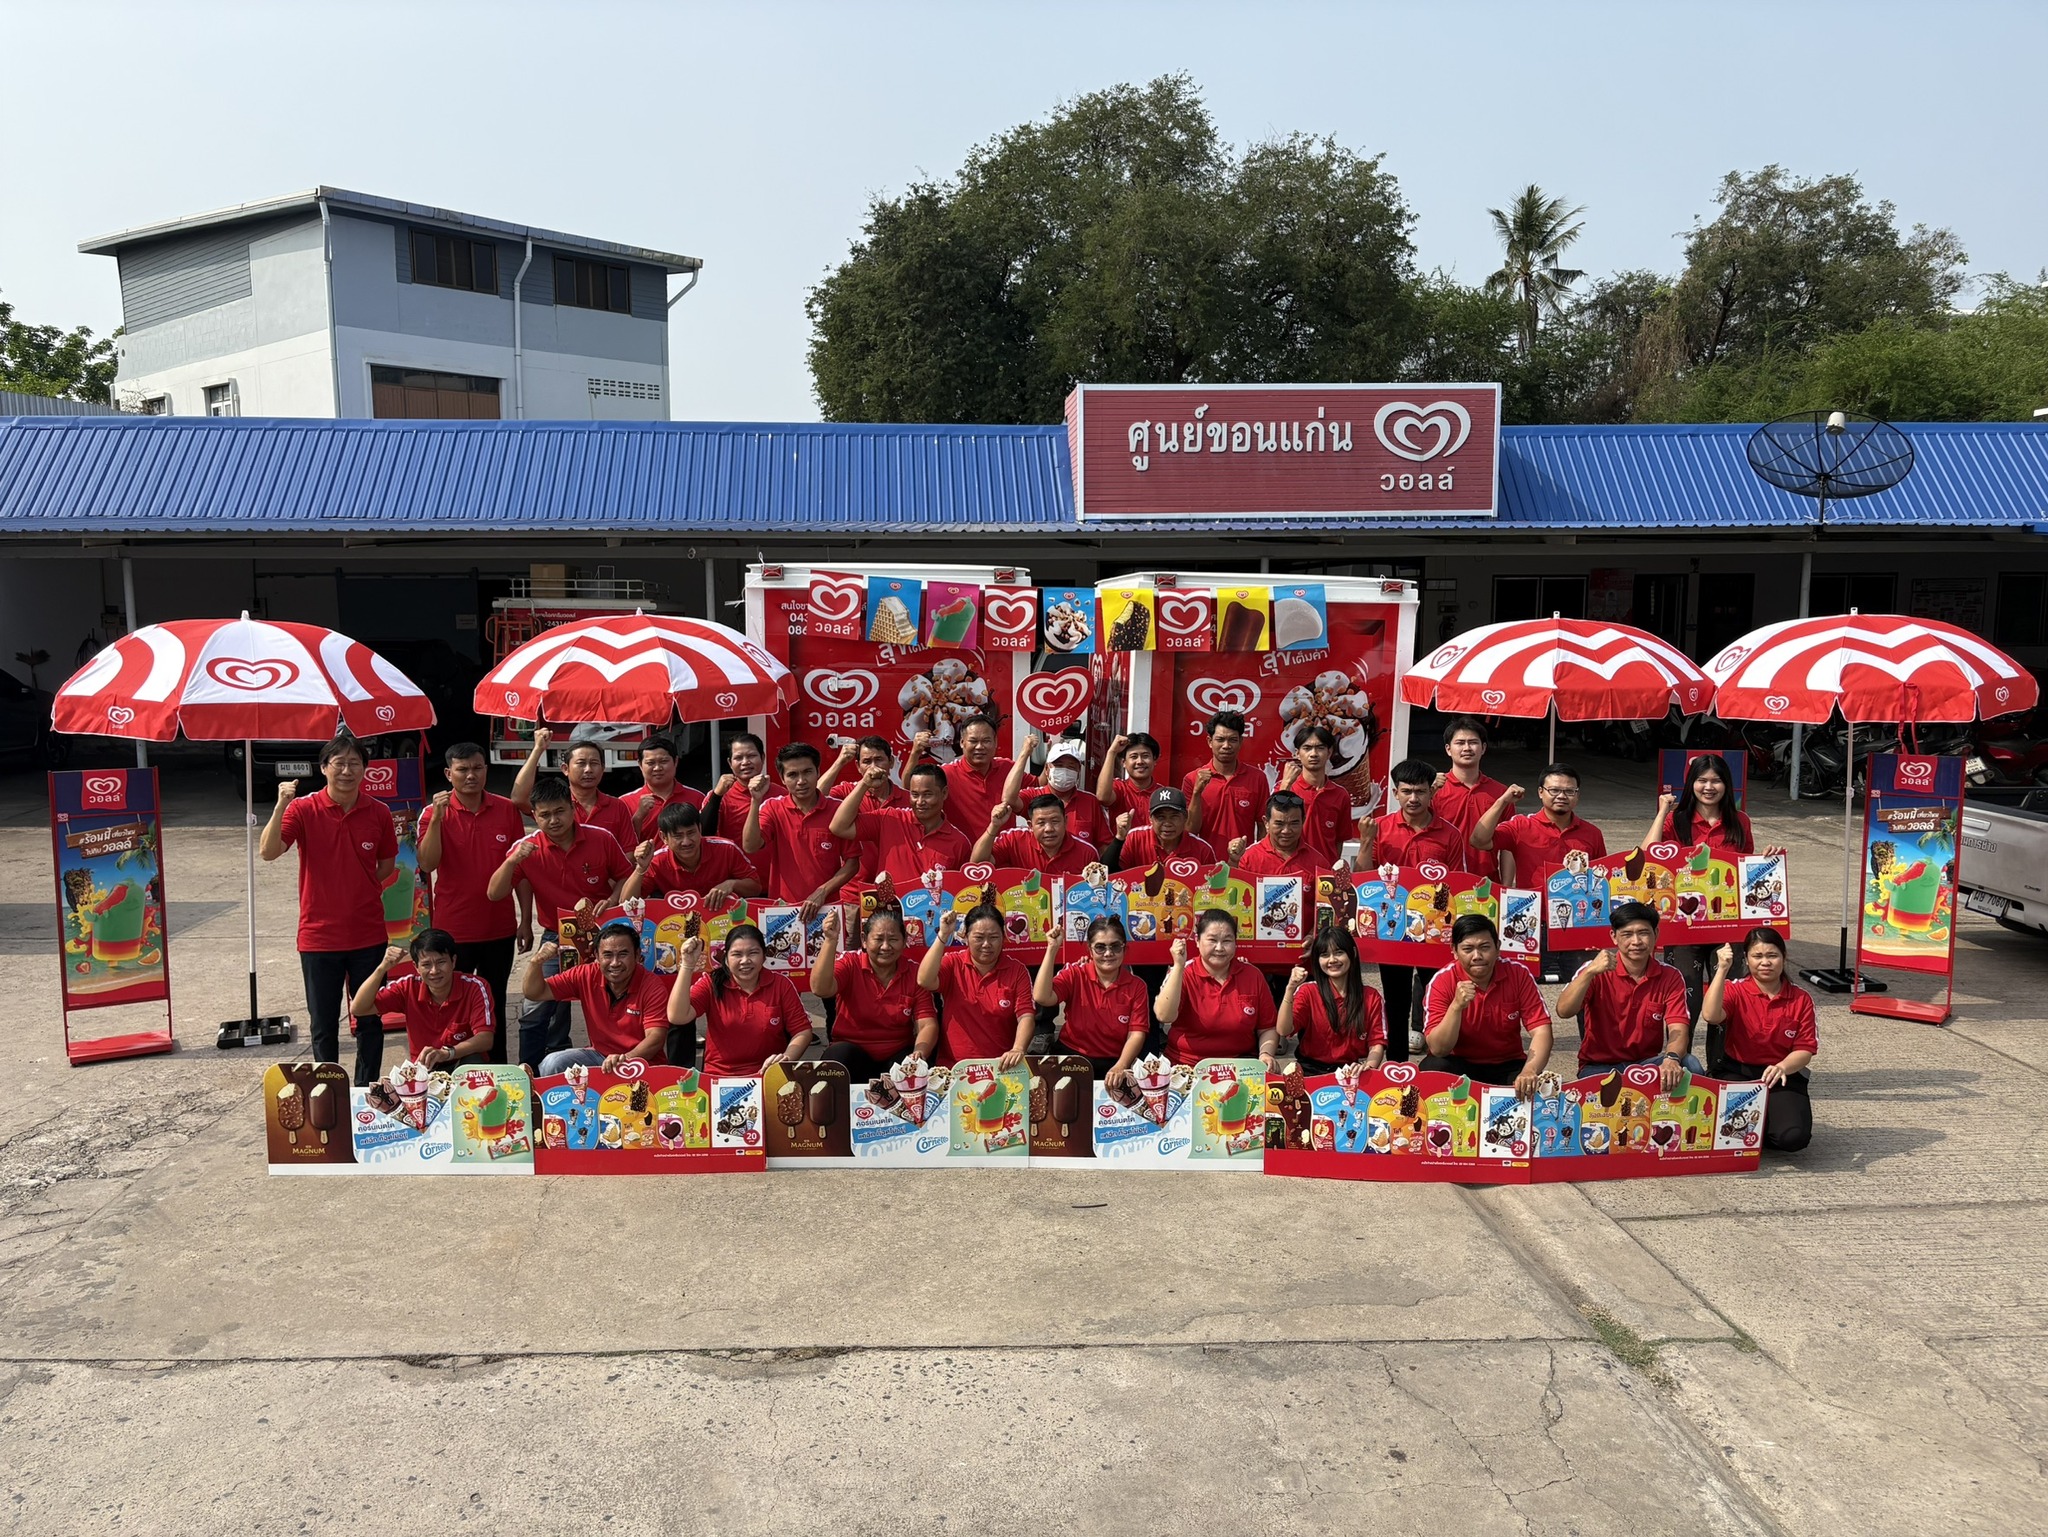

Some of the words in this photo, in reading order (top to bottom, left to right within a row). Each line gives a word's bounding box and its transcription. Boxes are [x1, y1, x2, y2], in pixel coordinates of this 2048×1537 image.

[1128, 404, 1353, 471] ศูนย์ขอนแก่น
[1379, 466, 1455, 491] วอลล์
[815, 622, 851, 635] วอลล์
[992, 634, 1028, 647] วอลล์
[1166, 635, 1202, 648] วอลล์
[808, 707, 876, 728] วอลล์
[1040, 715, 1070, 728] วอลล์
[365, 781, 393, 791] วอลล์
[1901, 777, 1930, 786] วอลล์
[89, 793, 120, 803] วอลล์
[464, 1070, 491, 1079] FRUITY
[964, 1063, 992, 1073] FRUITY
[1207, 1063, 1234, 1074] FRUITY
[1217, 1069, 1231, 1077] MAX
[420, 1142, 452, 1160] Cornetto
[916, 1135, 949, 1154] Cornetto
[1158, 1135, 1191, 1156] Cornetto
